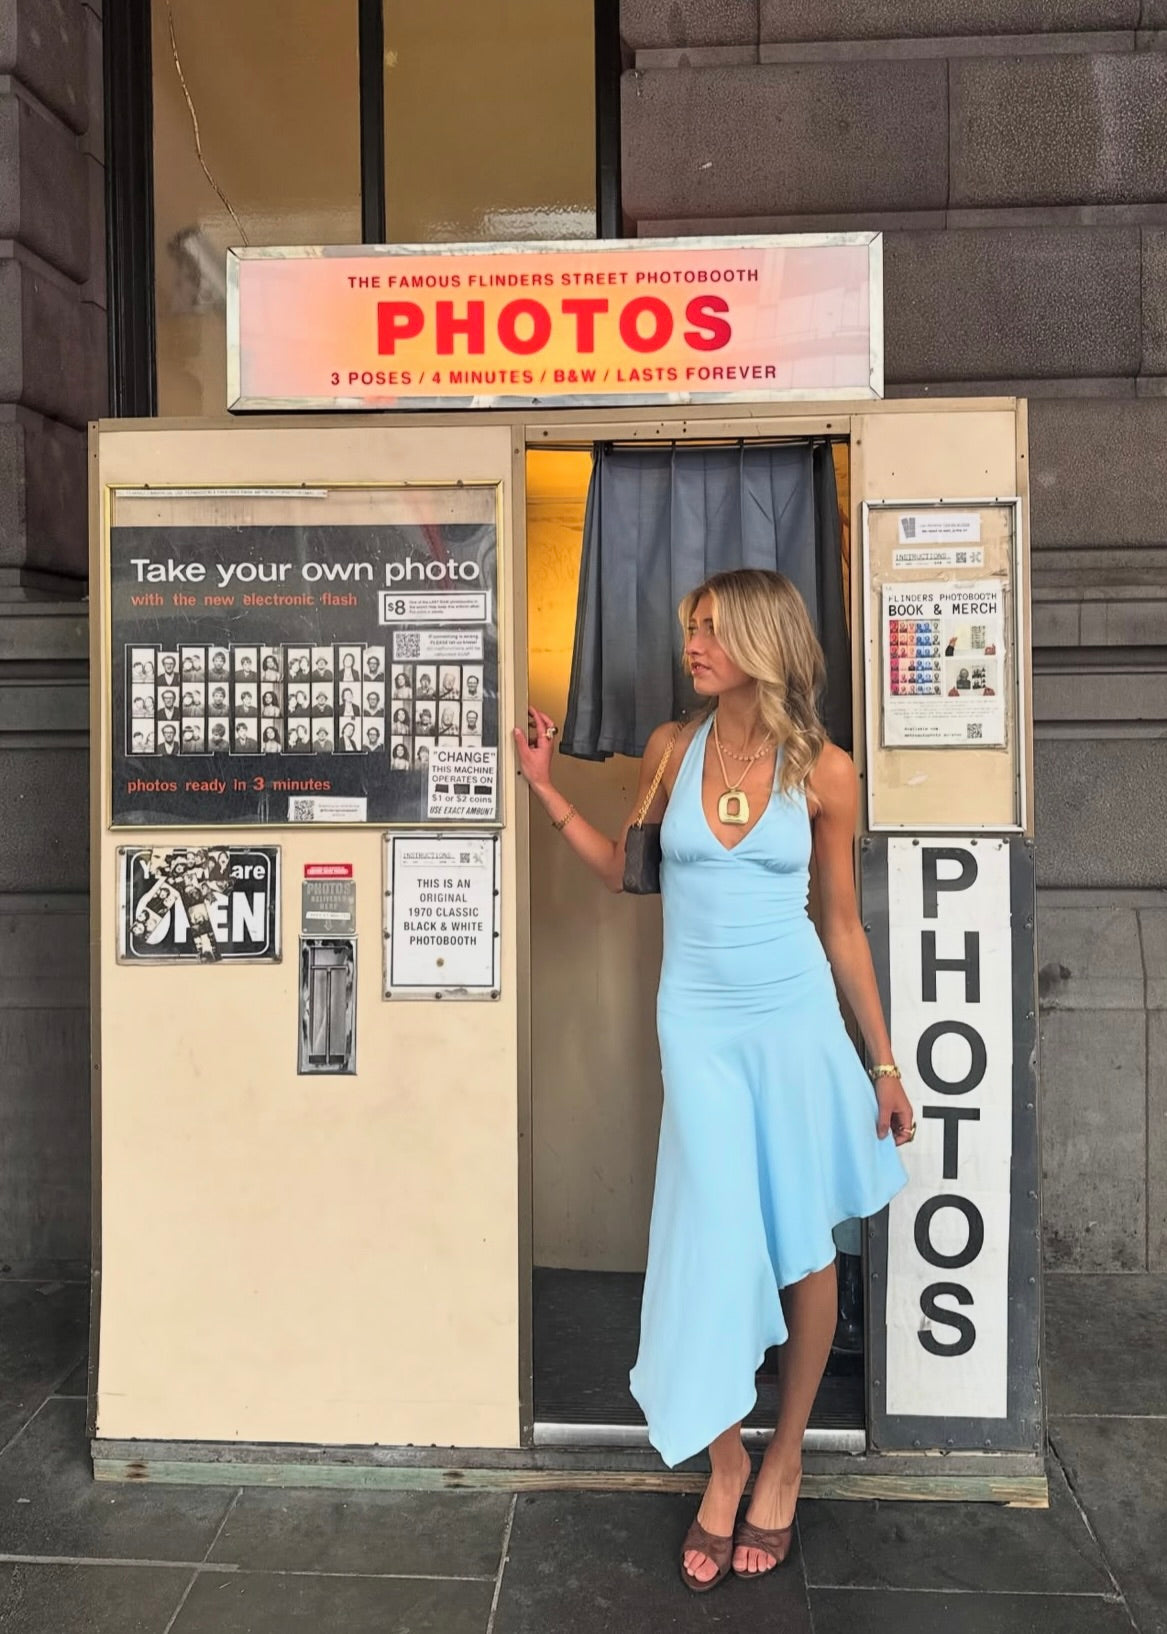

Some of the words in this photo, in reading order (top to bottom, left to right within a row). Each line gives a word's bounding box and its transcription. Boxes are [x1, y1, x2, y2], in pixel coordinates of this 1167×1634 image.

[348, 276, 380, 288] THE
[389, 275, 461, 288] FAMOUS
[468, 273, 554, 287] FLINDERS
[561, 272, 628, 285] STREET
[636, 269, 759, 284] PHOTOBOOTH
[377, 294, 732, 355] PHOTOS
[331, 371, 340, 385] 3
[349, 371, 412, 385] POSES
[419, 371, 425, 384] /
[432, 371, 441, 384] 4
[450, 369, 533, 384] MINUTES
[540, 370, 546, 383] /
[554, 368, 596, 383] B&W
[603, 368, 610, 382] /
[617, 367, 678, 382] LASTS
[686, 365, 777, 381] FOREVER
[130, 559, 207, 582] Take
[215, 562, 292, 588] your
[301, 562, 373, 582] own
[385, 557, 480, 587] photo
[131, 593, 164, 606] with
[173, 593, 197, 606] the
[204, 595, 235, 606] new
[243, 592, 315, 606] electronic
[322, 592, 358, 606] flash
[888, 594, 934, 602] FLINDERS
[940, 592, 997, 601] PHOTOBOOTH
[388, 600, 406, 615] $8
[888, 604, 923, 616] BOOK
[933, 604, 942, 615] &
[952, 602, 997, 615] MERCH
[433, 751, 496, 763] "CHANGE"
[432, 765, 451, 773] THIS
[454, 766, 494, 774] MACHINE
[127, 778, 177, 793] photos
[185, 779, 226, 794] ready
[234, 779, 246, 791] in
[253, 777, 265, 791] 3
[273, 778, 331, 791] minutes
[432, 775, 477, 783] OPERATES
[480, 776, 493, 784] ON
[430, 806, 442, 814] USE
[231, 865, 266, 880] are
[417, 878, 440, 888] THIS
[443, 878, 453, 888] IS
[457, 878, 471, 888] AN
[419, 893, 467, 902] ORIGINAL
[408, 907, 432, 917] 1970
[435, 907, 479, 917] CLASSIC
[403, 921, 437, 931] BLACK
[440, 921, 447, 931] &
[451, 921, 483, 931] WHITE
[409, 935, 477, 945] PHOTOBOOTH
[913, 846, 988, 1357] PHOTOS
